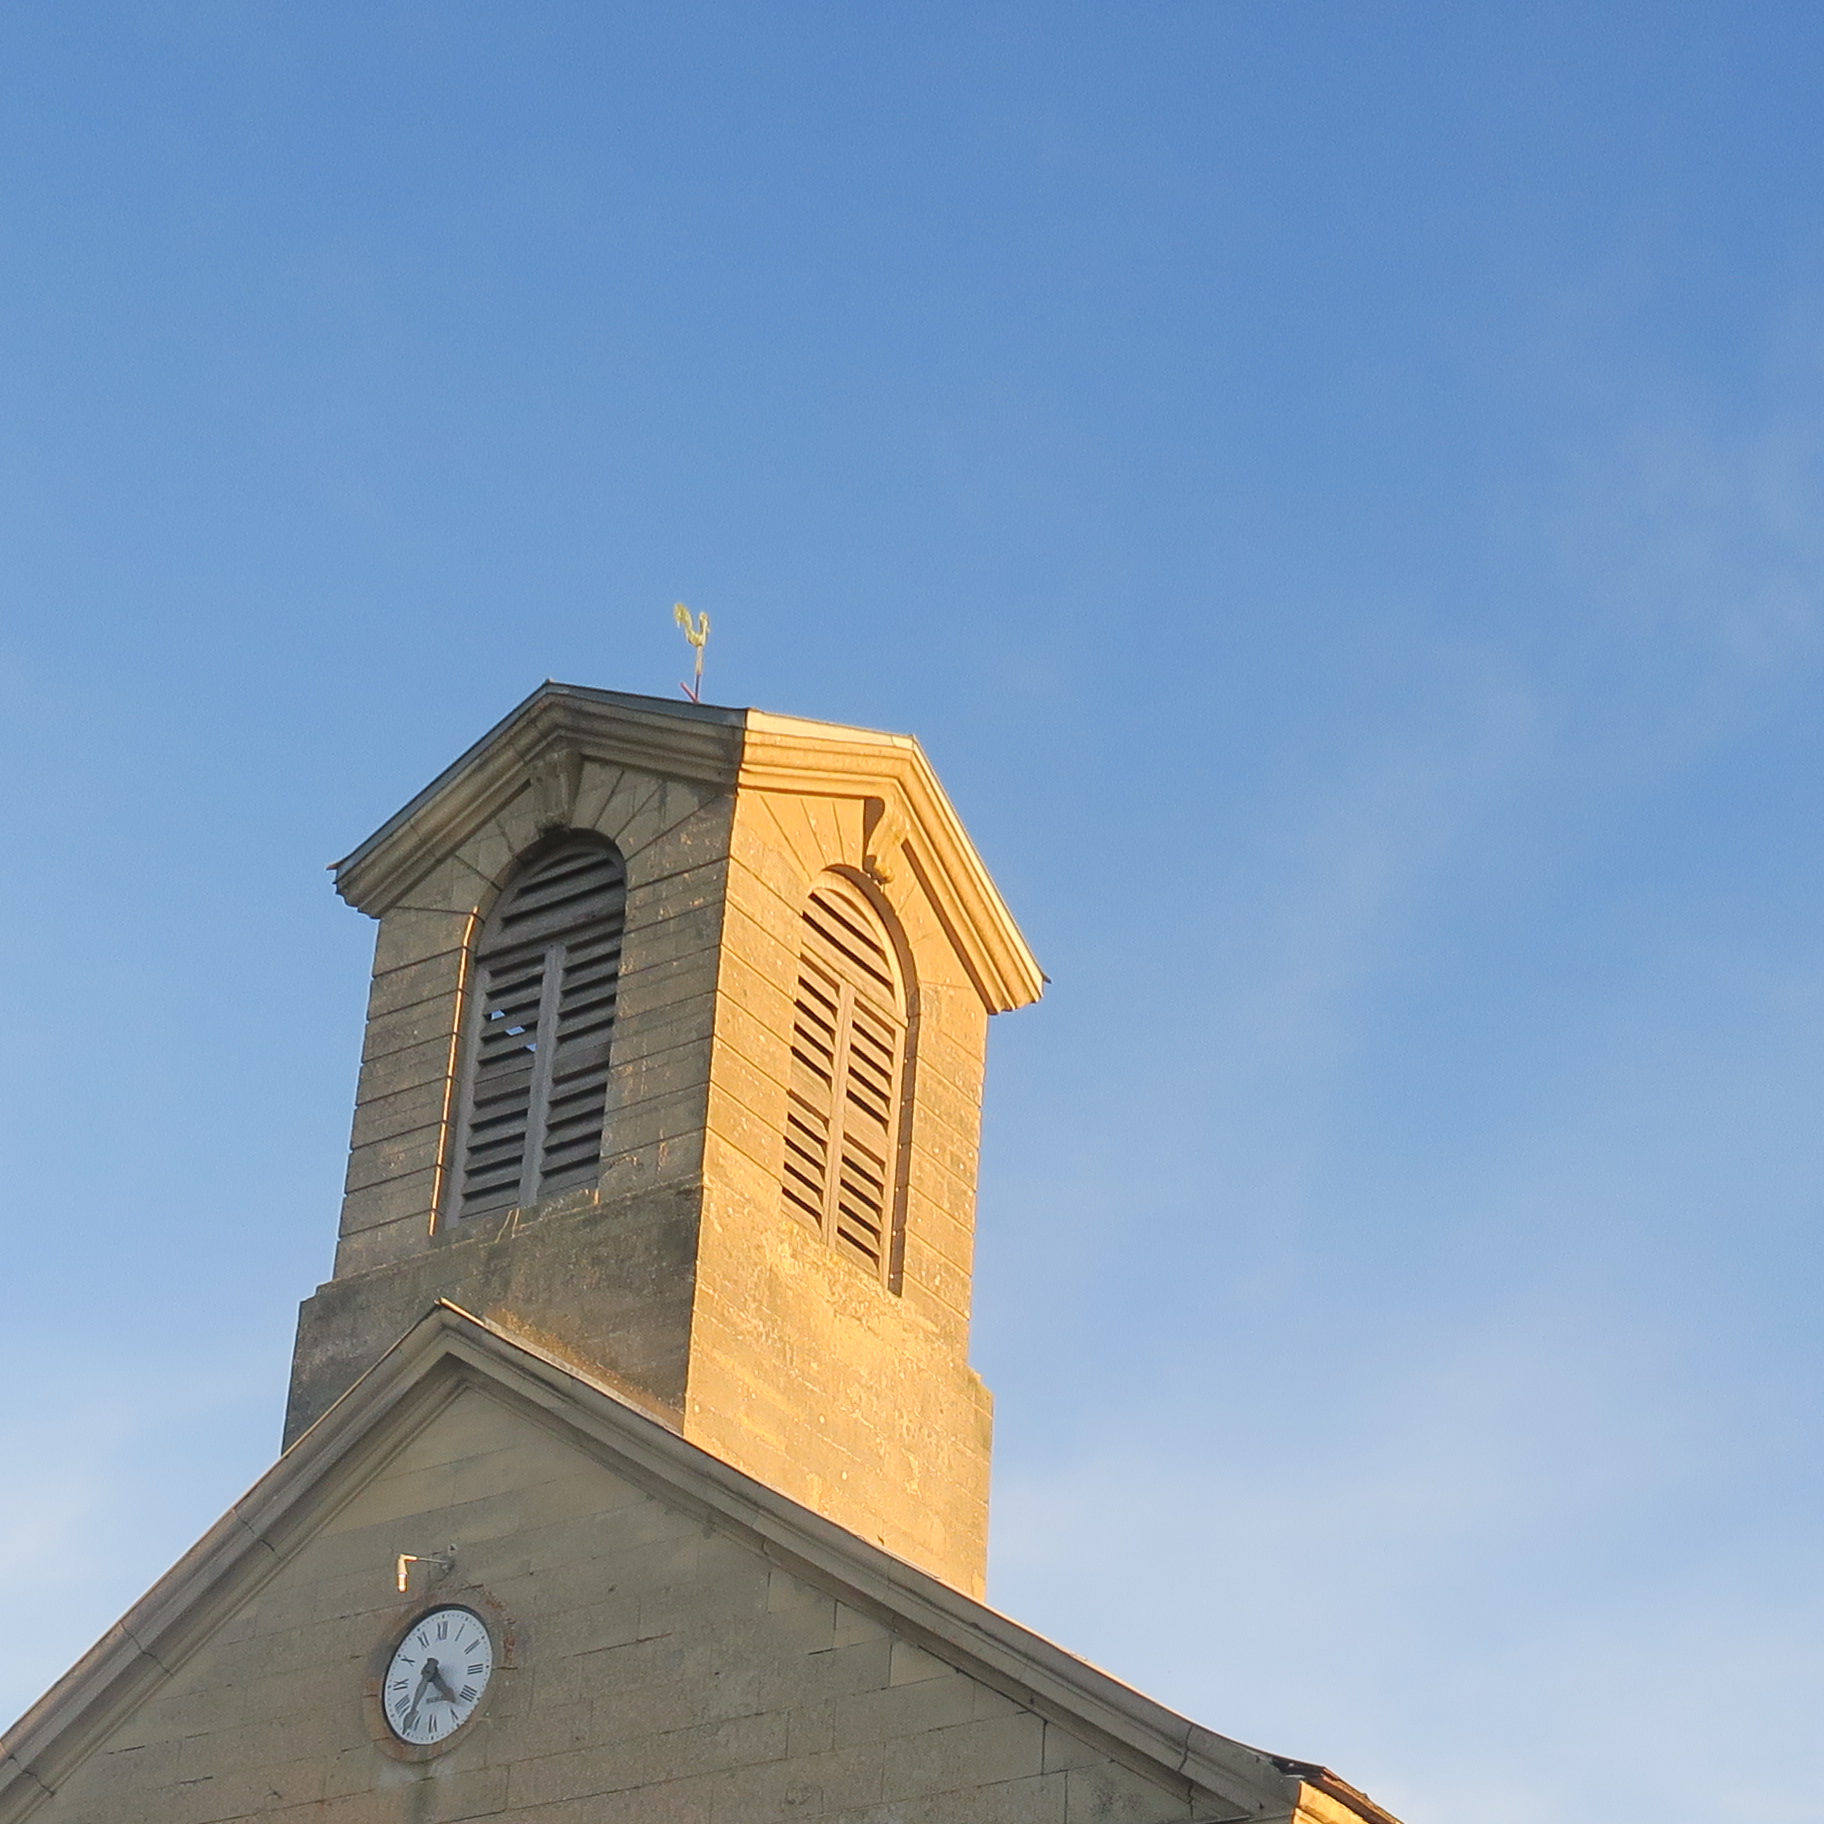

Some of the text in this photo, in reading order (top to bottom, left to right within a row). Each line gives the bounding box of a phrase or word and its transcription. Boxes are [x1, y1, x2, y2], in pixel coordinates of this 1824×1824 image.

[455, 1623, 465, 1642] I
[464, 1639, 480, 1655] II
[401, 1655, 415, 1667] X
[467, 1663, 484, 1675] III
[393, 1679, 409, 1691] IX
[459, 1685, 478, 1702] IIII
